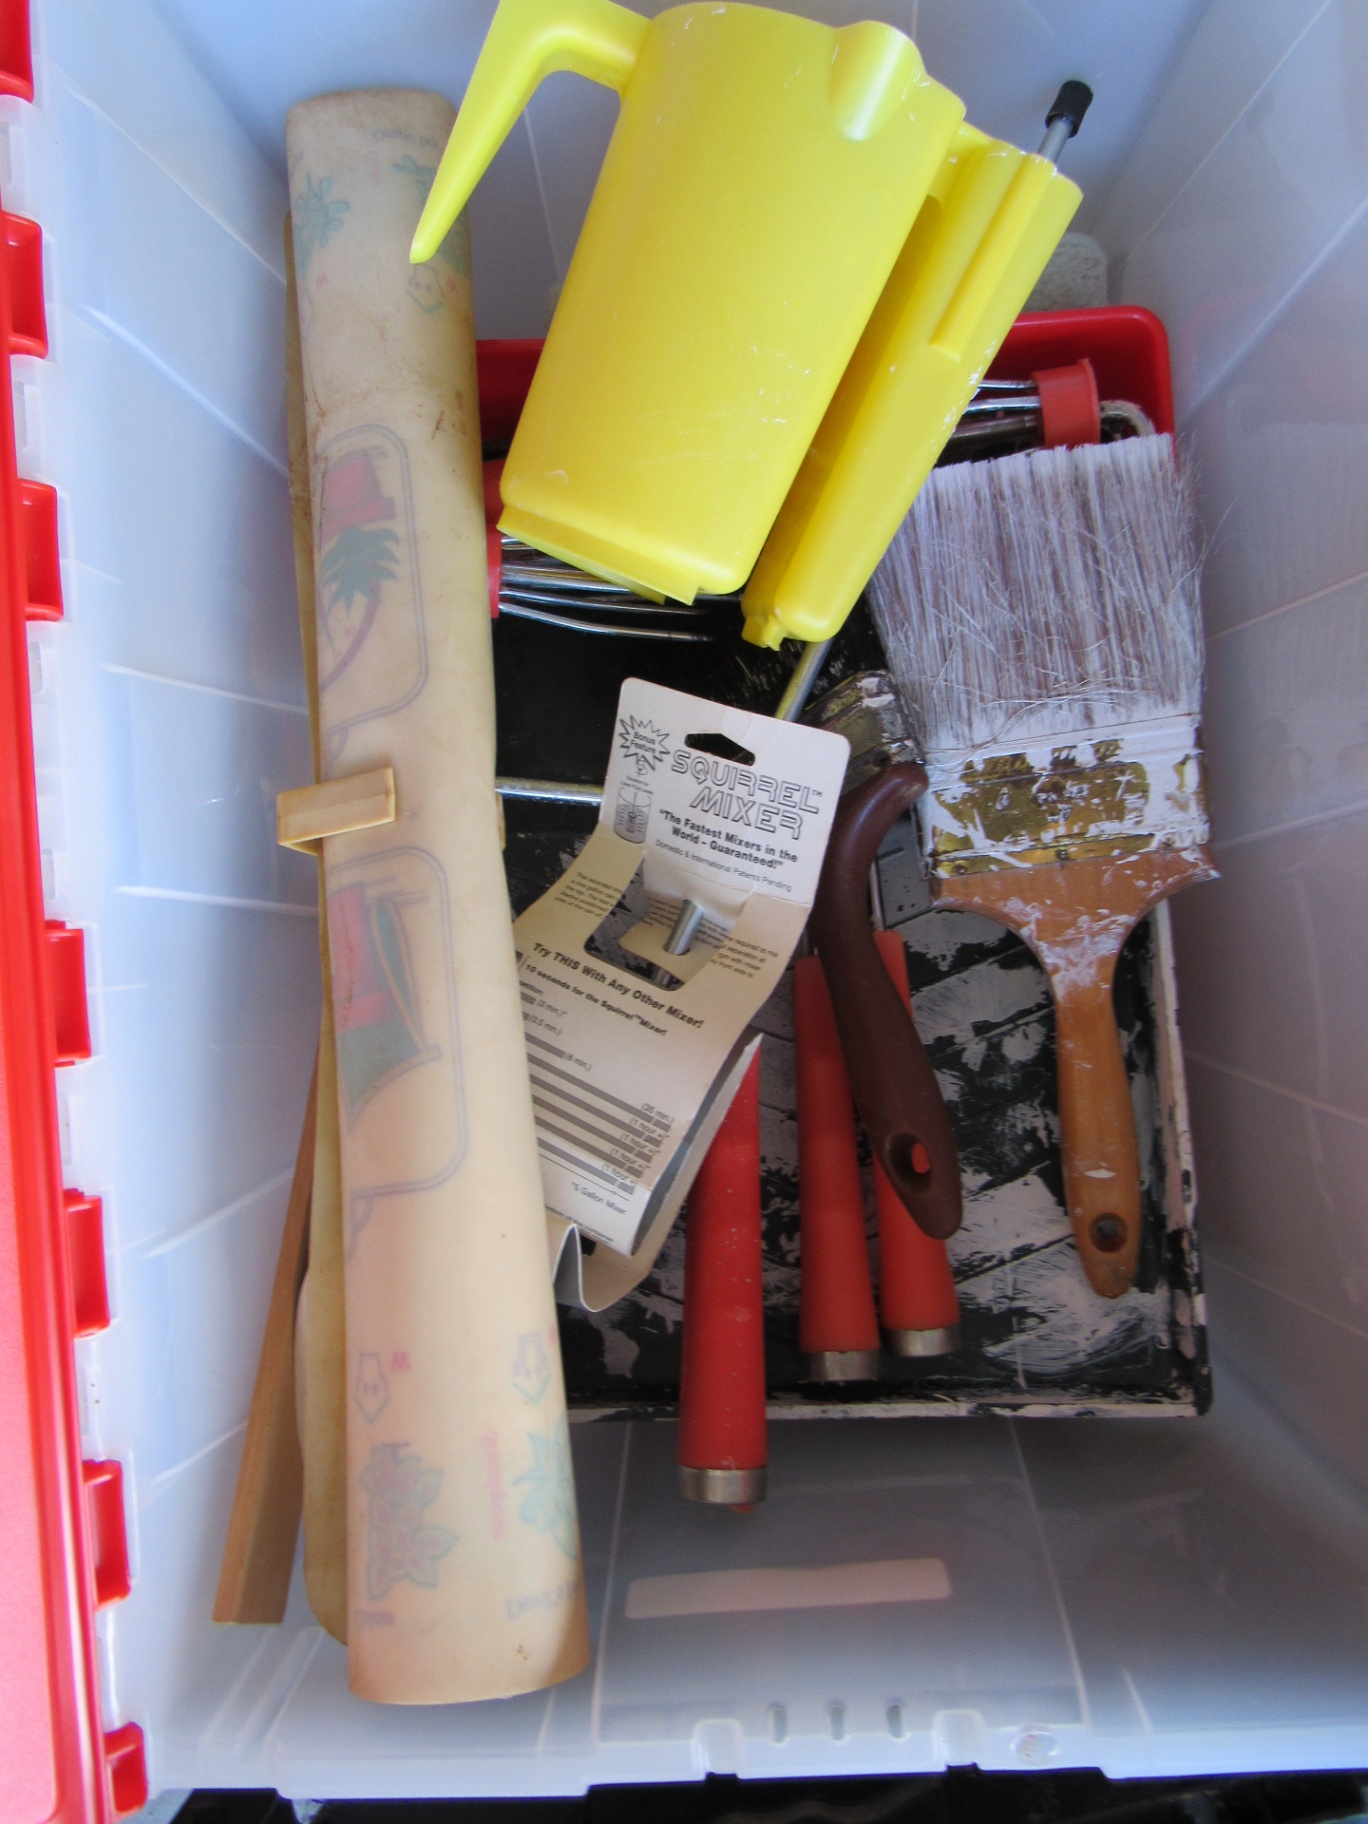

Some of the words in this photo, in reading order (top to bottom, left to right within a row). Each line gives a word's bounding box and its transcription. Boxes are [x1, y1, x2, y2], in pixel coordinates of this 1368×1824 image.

[631, 739, 656, 753] Feature
[634, 731, 655, 745] Bonus
[690, 786, 803, 840] MIXER
[672, 826, 700, 844] World
[684, 819, 722, 839] Fastest
[725, 832, 761, 852] Mixers
[765, 844, 776, 857] in
[779, 850, 798, 862] the
[655, 838, 683, 857] Domestic
[684, 850, 689, 858] &
[690, 851, 731, 873] International
[733, 867, 760, 882] Patents
[762, 876, 792, 892] Pending
[525, 963, 536, 973] 10
[536, 969, 571, 990] seconds
[572, 986, 585, 996] for
[585, 992, 599, 1004] the
[533, 942, 551, 958] Try
[553, 951, 580, 970] THIS
[582, 964, 606, 983] With
[607, 978, 631, 995] Any
[632, 990, 665, 1010] Other
[665, 1004, 704, 1029] Mixer!
[639, 1119, 657, 1134] hour
[629, 1135, 648, 1150] hour
[619, 1152, 638, 1166] hour
[610, 1167, 628, 1181] hour
[580, 1186, 604, 1202] Gallon
[606, 1200, 627, 1215] Mixer
